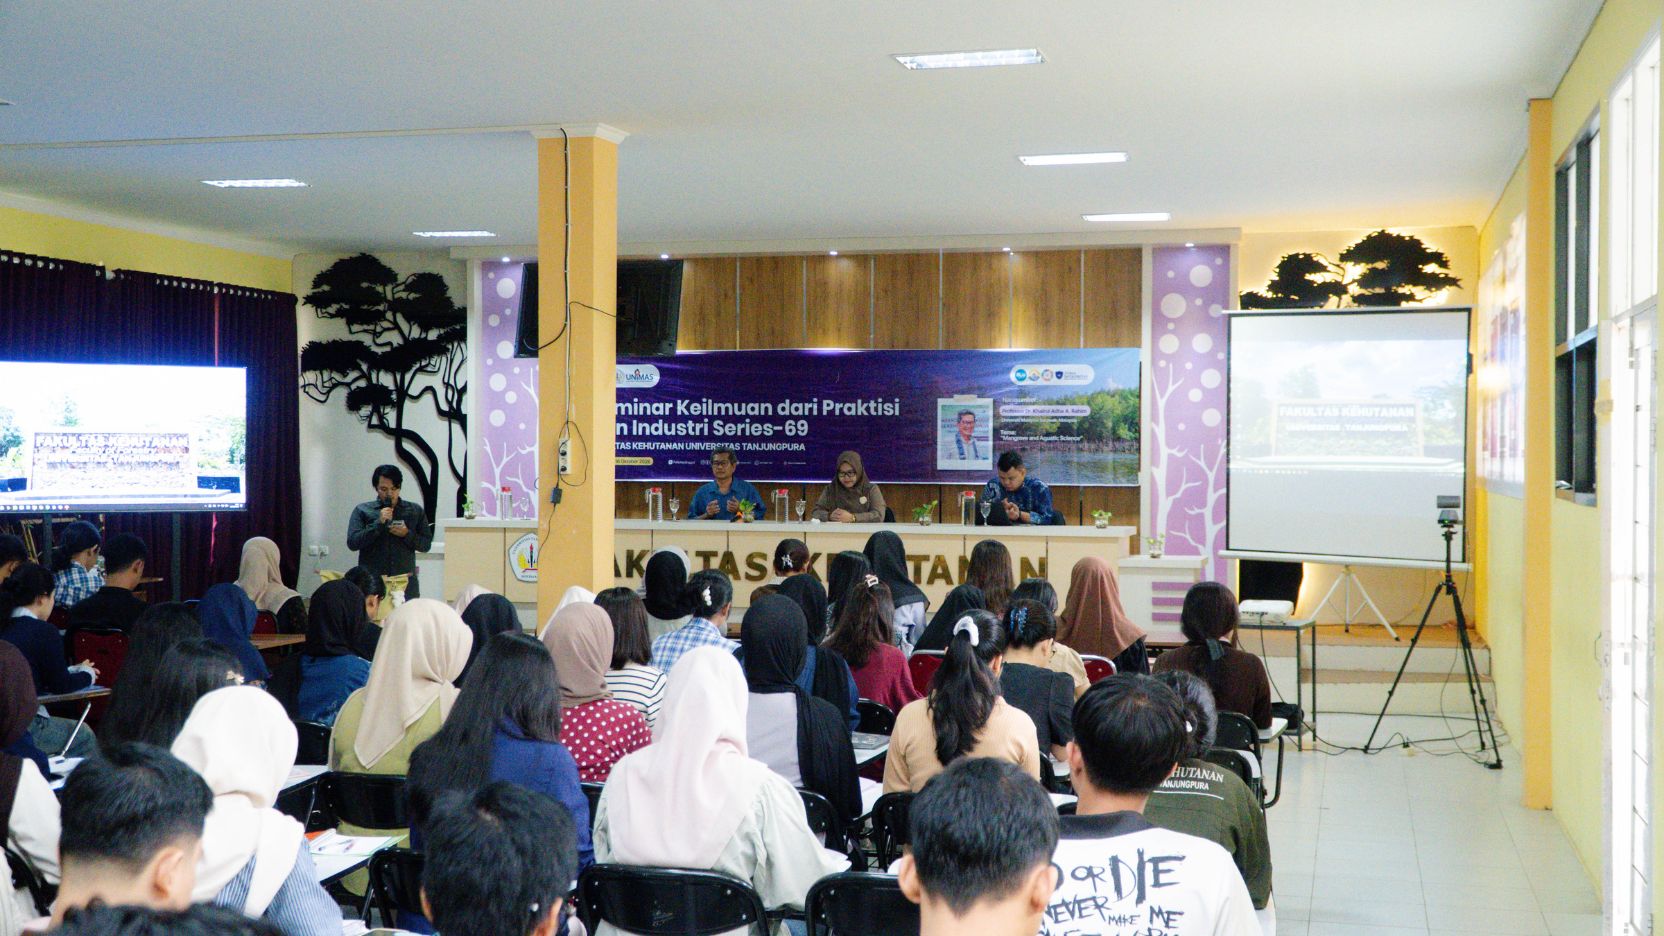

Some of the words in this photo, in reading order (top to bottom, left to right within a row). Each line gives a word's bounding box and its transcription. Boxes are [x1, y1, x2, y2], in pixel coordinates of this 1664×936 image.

[625, 373, 654, 381] UNIMAS
[615, 397, 673, 416] minar
[676, 397, 773, 416] Keilmuan
[777, 397, 818, 416] dari
[822, 397, 900, 416] Praktisi
[632, 418, 709, 436] Industri
[712, 418, 809, 437] Series-69
[632, 442, 684, 450] KEHUTANAN
[741, 442, 806, 451] TANJUNGPURA
[1171, 766, 1225, 783] HUTANAN
[1159, 780, 1210, 791] ANJUNGPURA
[1070, 865, 1107, 893] OR
[1108, 847, 1186, 907] DIE
[1149, 905, 1185, 929] ME
